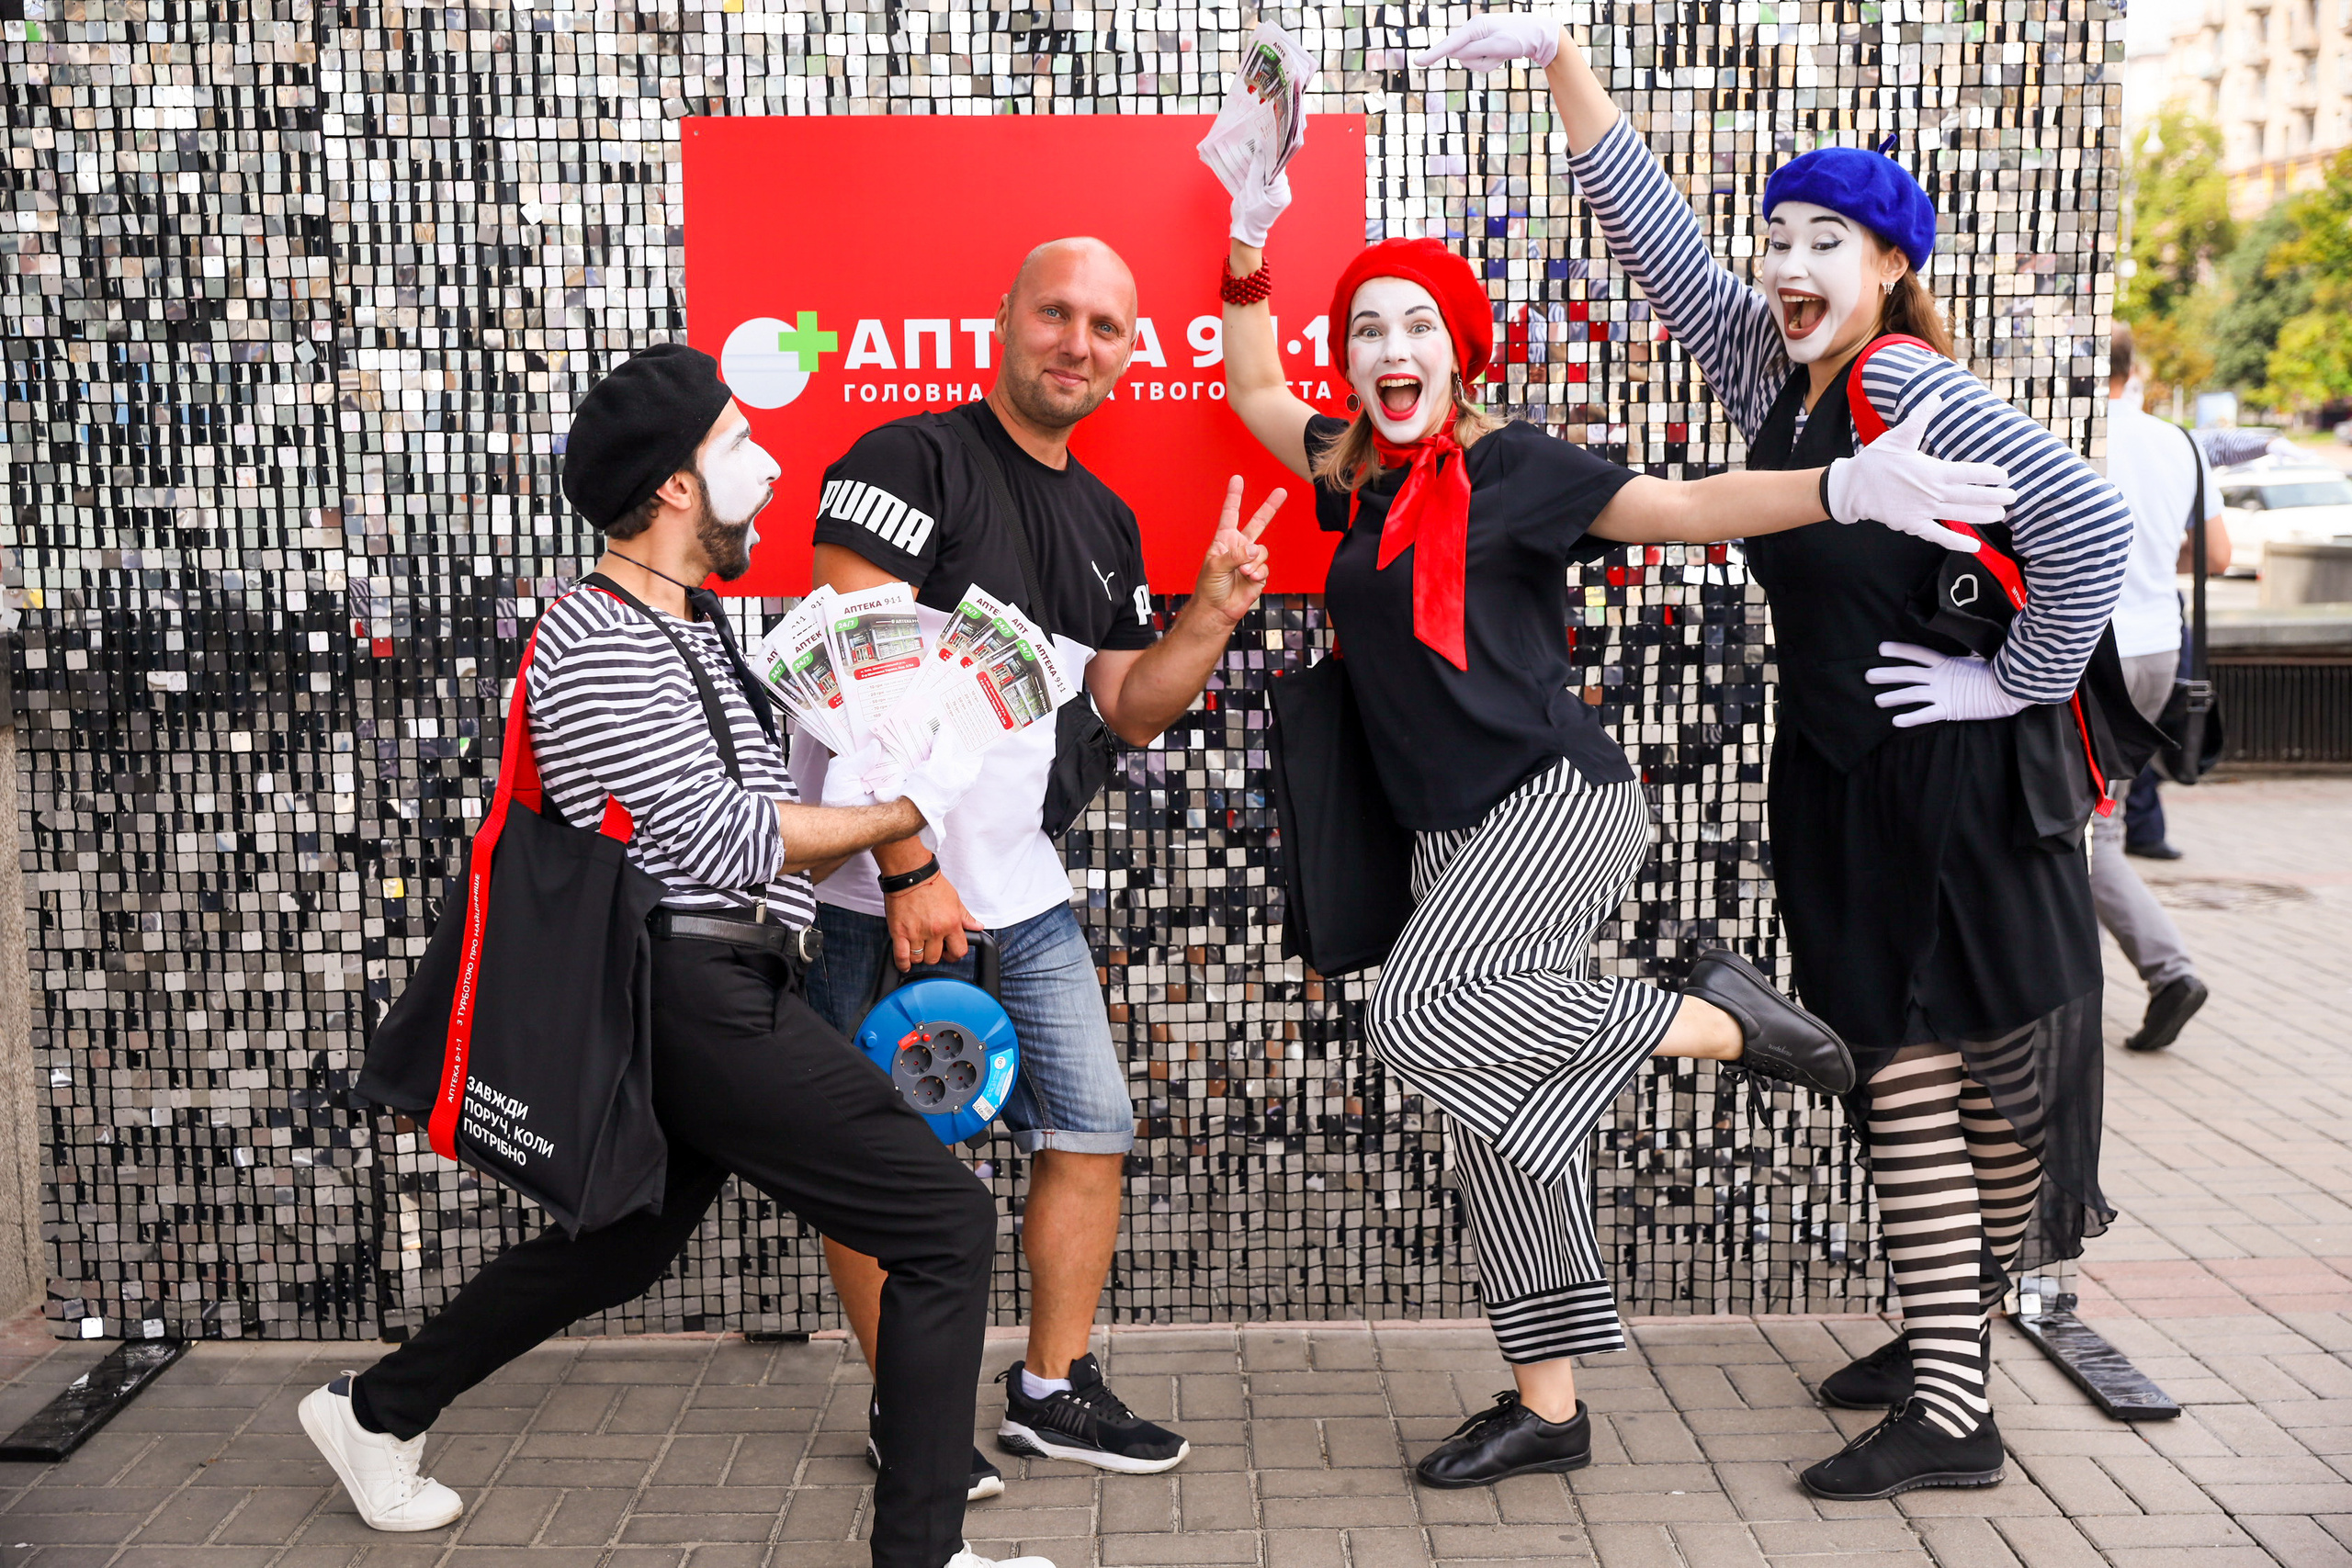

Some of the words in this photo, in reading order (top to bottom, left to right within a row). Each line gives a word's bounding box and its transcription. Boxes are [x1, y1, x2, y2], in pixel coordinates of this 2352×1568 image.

[844, 318, 1168, 369] АПТА
[843, 383, 984, 402] ГОЛОВНА
[1130, 381, 1227, 400] ТВОГО
[816, 479, 935, 557] PUMA
[843, 600, 882, 615] АПТЕКА
[962, 604, 978, 616] 24/7
[837, 620, 855, 629] 24/7
[995, 618, 1011, 635] 24/7
[795, 630, 822, 654] АПТЕК
[1019, 641, 1033, 659] 24/7
[771, 663, 785, 680] 24/7
[795, 654, 811, 670] 24/7
[1035, 643, 1057, 677] АПТЕКА
[469, 939, 479, 960] ПРО
[457, 962, 474, 1016] ТУРБОТОЮ
[454, 1038, 463, 1063] 9-1-1
[447, 1064, 460, 1103] АПТЕКА
[467, 1076, 529, 1121] ЗАВЖДИ
[464, 1096, 511, 1139] ПОРУЧ,
[514, 1125, 555, 1158] КОЛИ
[464, 1117, 527, 1166] ПОТРІБНО
